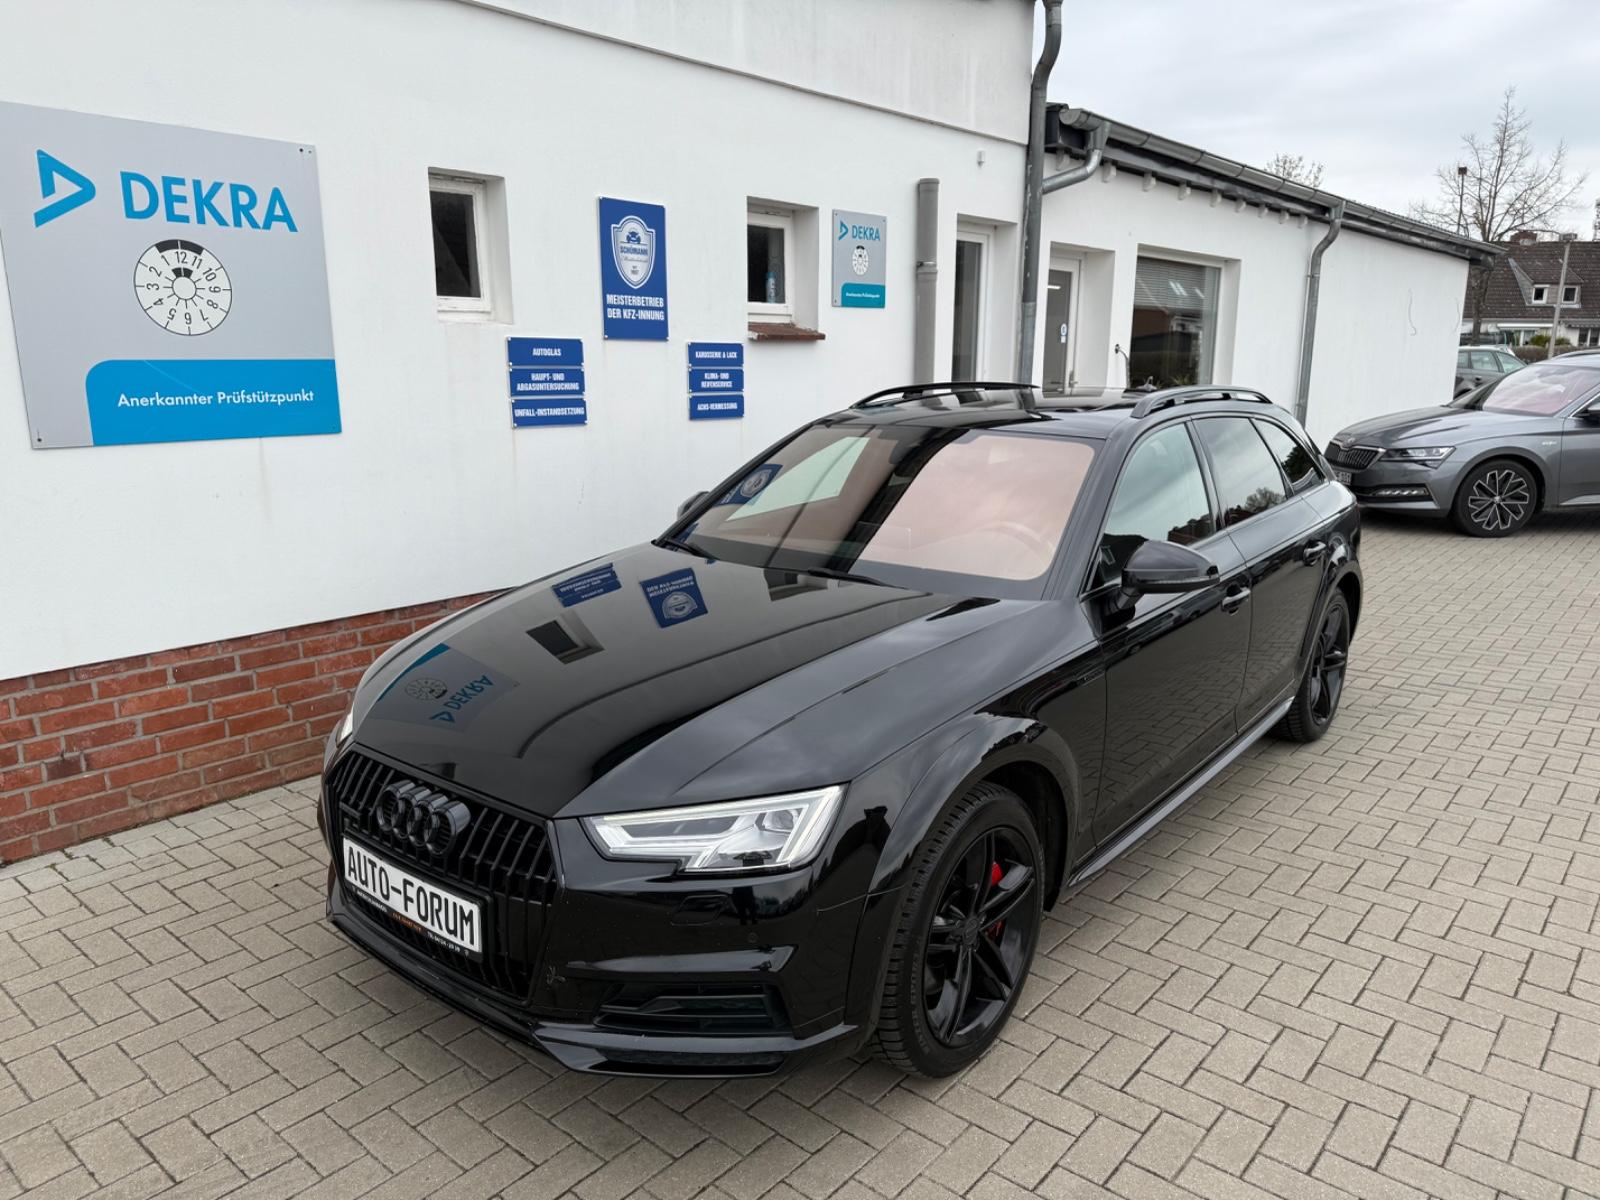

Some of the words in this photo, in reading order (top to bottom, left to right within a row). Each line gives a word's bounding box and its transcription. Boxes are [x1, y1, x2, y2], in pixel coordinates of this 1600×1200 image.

[119, 170, 299, 233] DEKRA
[851, 224, 881, 241] DEKRA
[160, 254, 170, 266] 1
[174, 251, 188, 264] 12
[191, 255, 203, 269] 11
[148, 266, 162, 277] 2
[202, 267, 217, 282] 10
[146, 283, 159, 291] 3
[153, 298, 164, 306] 4
[206, 299, 219, 309] 8
[606, 294, 665, 308] MEISTERBETRIEB
[167, 308, 177, 321] 5
[184, 312, 192, 325] 6
[199, 309, 209, 321] 7
[607, 307, 622, 319] DER
[622, 308, 665, 321] KFZ-INNUNG
[532, 347, 562, 357] AUTOGLAS
[530, 372, 552, 381] HAUPT-
[552, 372, 565, 381] UND
[516, 382, 580, 392] ABGASUNTERSUCHUNG
[117, 391, 213, 408] Anerkannter
[216, 388, 315, 406] Prüfstützpunkt
[513, 407, 585, 417] UNFALL-INSTANDSETZUNG
[347, 845, 475, 946] AUTO-FORUM
